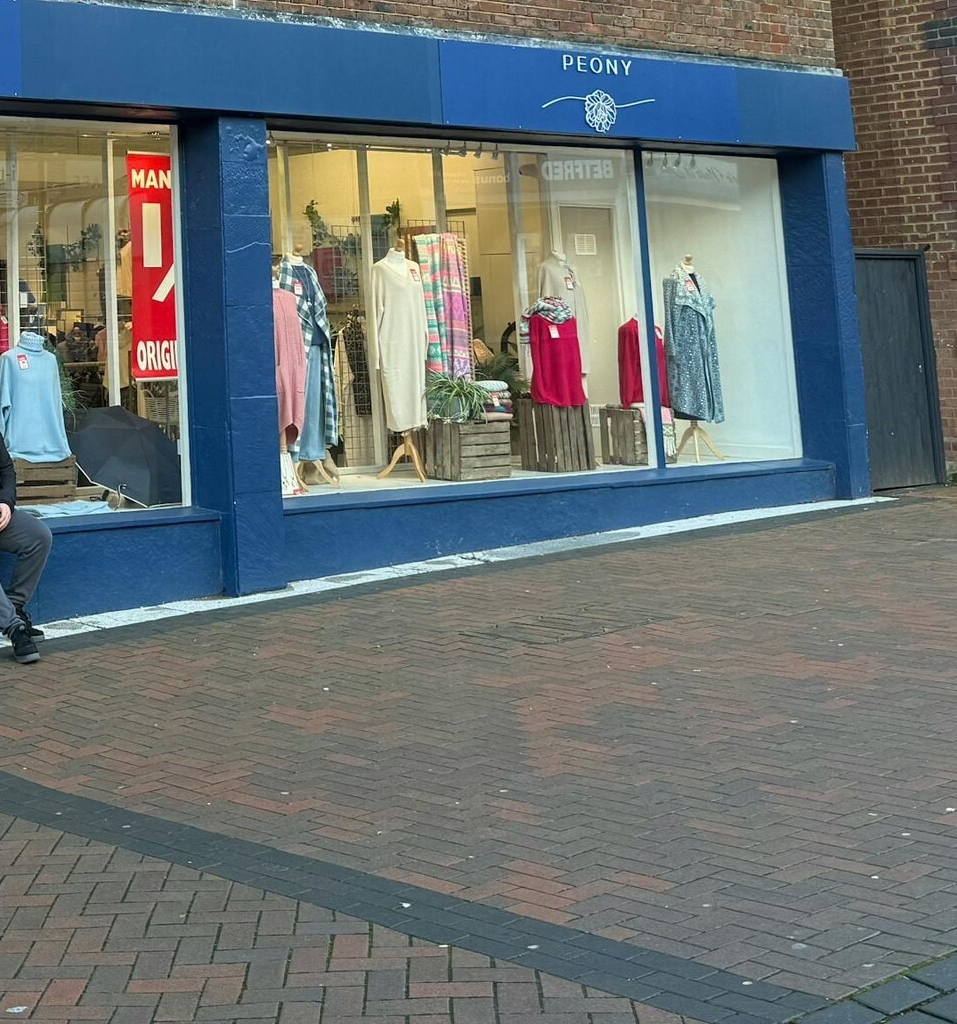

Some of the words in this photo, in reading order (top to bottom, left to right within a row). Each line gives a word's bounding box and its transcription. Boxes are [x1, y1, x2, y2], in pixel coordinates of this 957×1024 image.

[562, 54, 632, 76] PEONY
[131, 168, 172, 189] MAN
[136, 339, 179, 371] ORIGI
